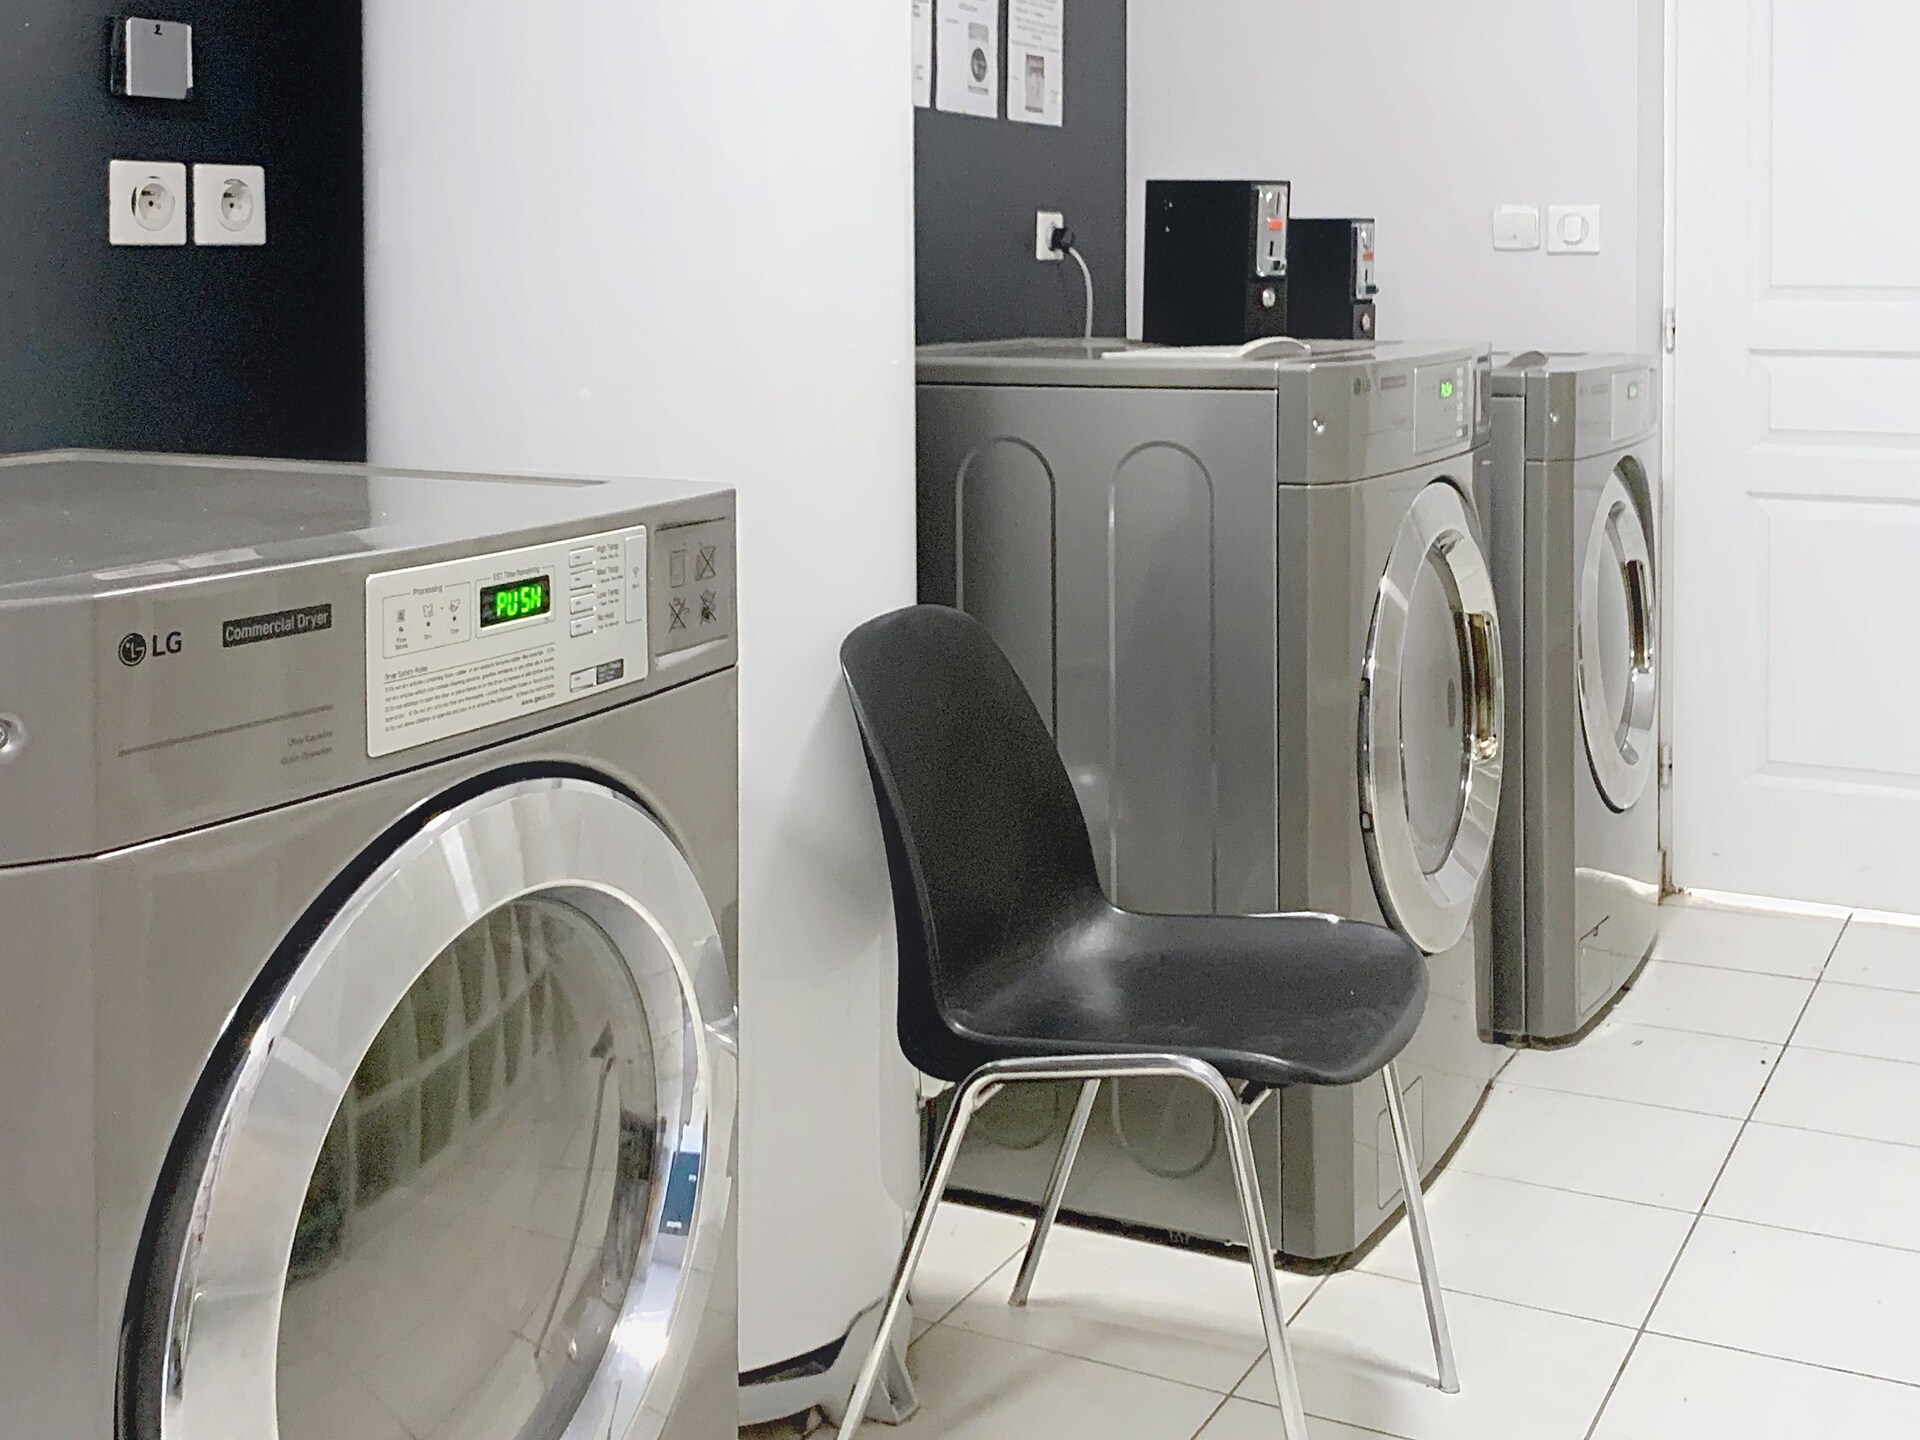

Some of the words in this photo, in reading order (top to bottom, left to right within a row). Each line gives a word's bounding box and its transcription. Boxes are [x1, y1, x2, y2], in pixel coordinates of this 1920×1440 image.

[153, 24, 163, 36] 2
[412, 585, 443, 596] Processing
[496, 584, 541, 617] PUSH
[224, 616, 295, 642] Commercial
[297, 611, 330, 631] Dryer
[151, 631, 183, 657] LG
